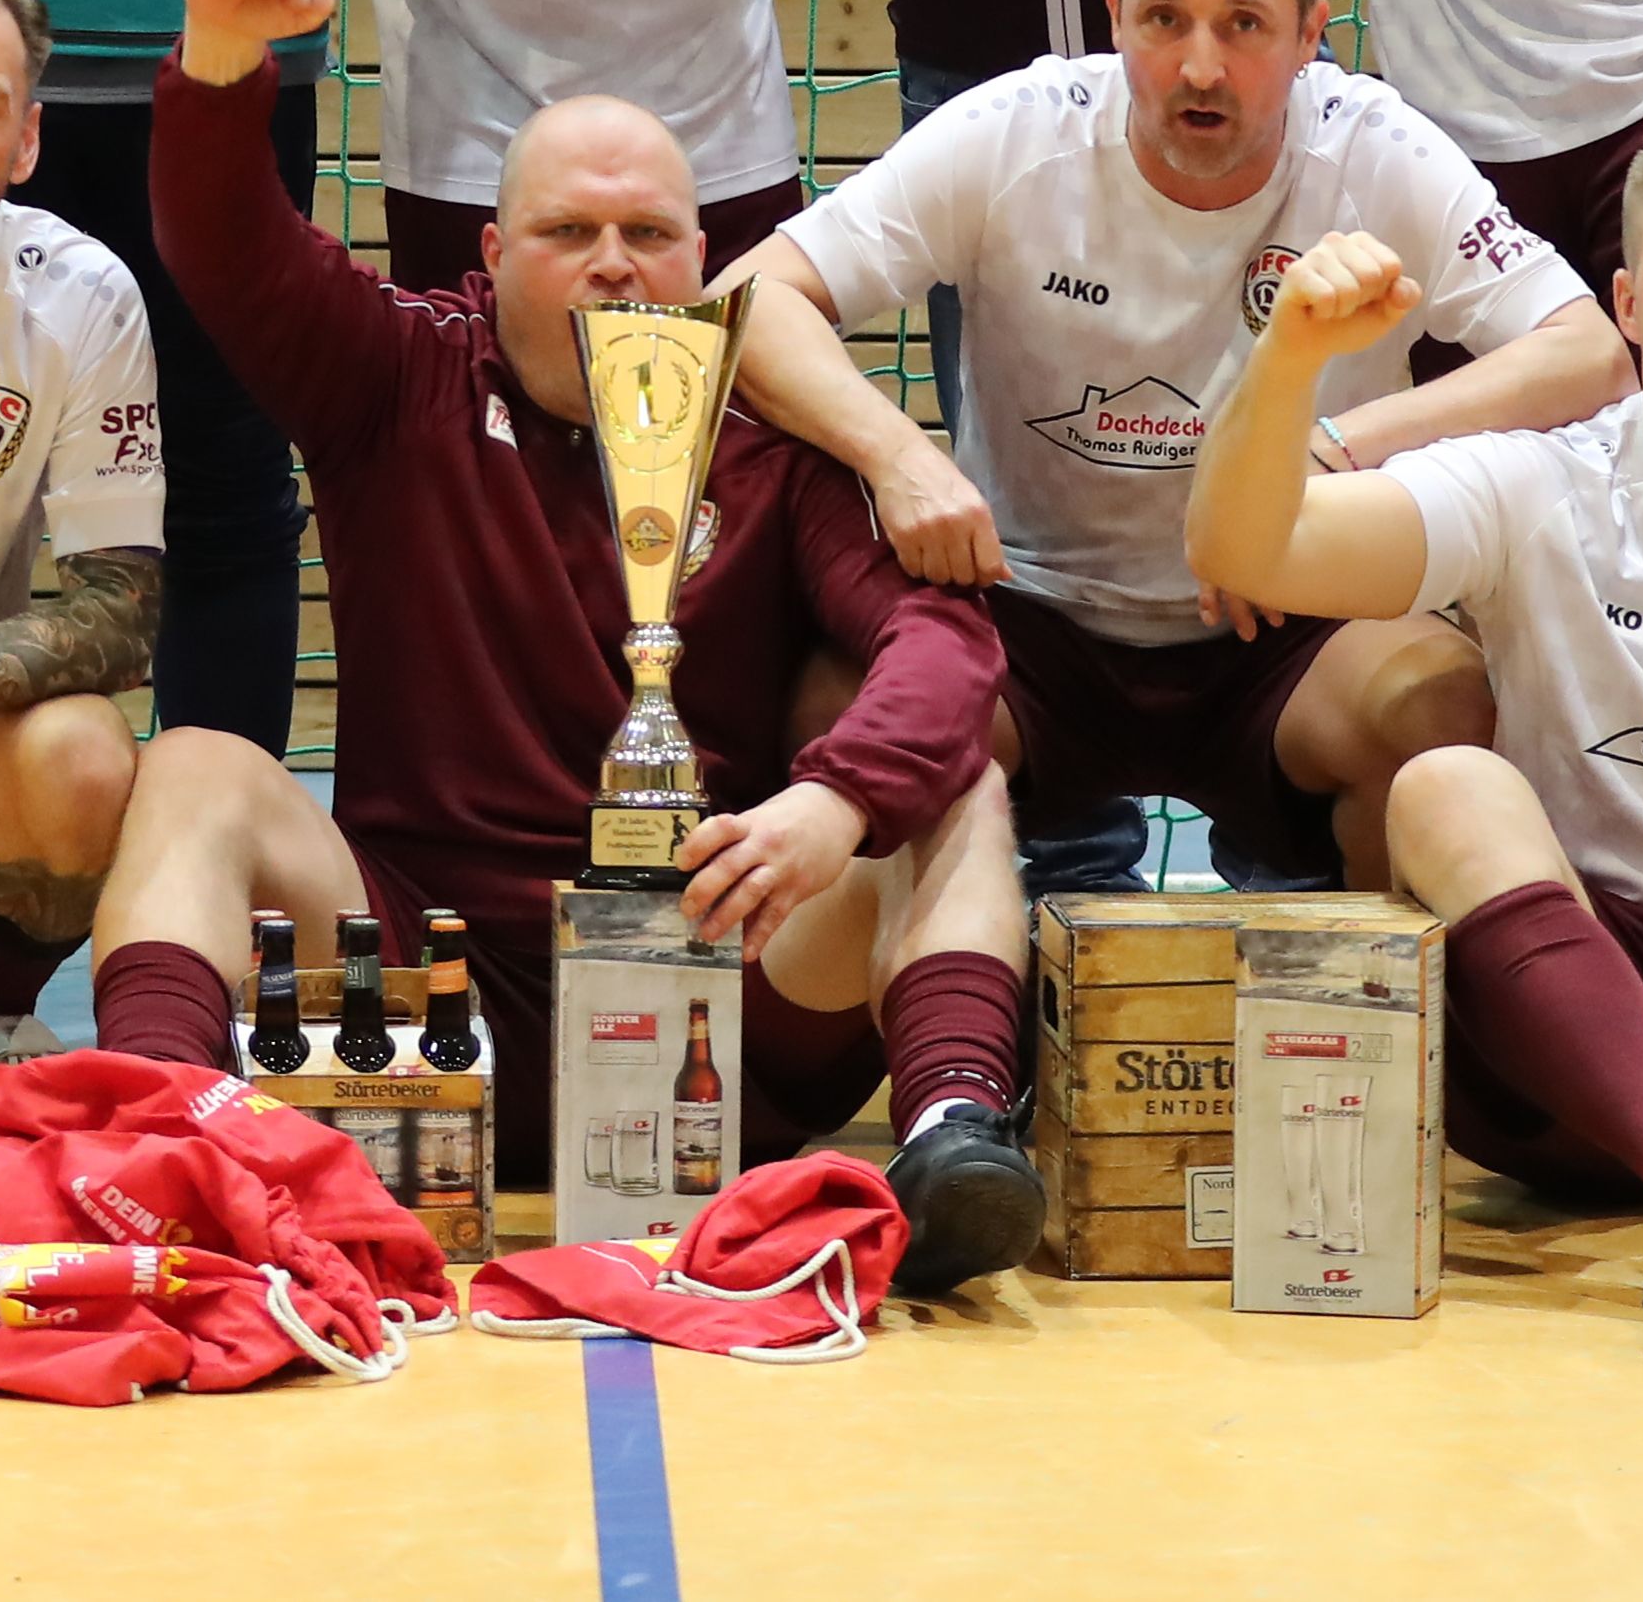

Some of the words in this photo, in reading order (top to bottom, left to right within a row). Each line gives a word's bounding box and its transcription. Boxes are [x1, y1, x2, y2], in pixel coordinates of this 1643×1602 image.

[1041, 271, 1110, 306] JAKO
[627, 360, 665, 429] 1
[1066, 426, 1127, 454] Thomas
[1132, 439, 1197, 461] Rüdiger
[592, 1014, 640, 1025] SCOTCH
[592, 1023, 616, 1033] ALE
[333, 1079, 442, 1099] Störtebeker
[100, 1184, 162, 1237] DEIN
[1283, 1282, 1364, 1299] Störtebeker
